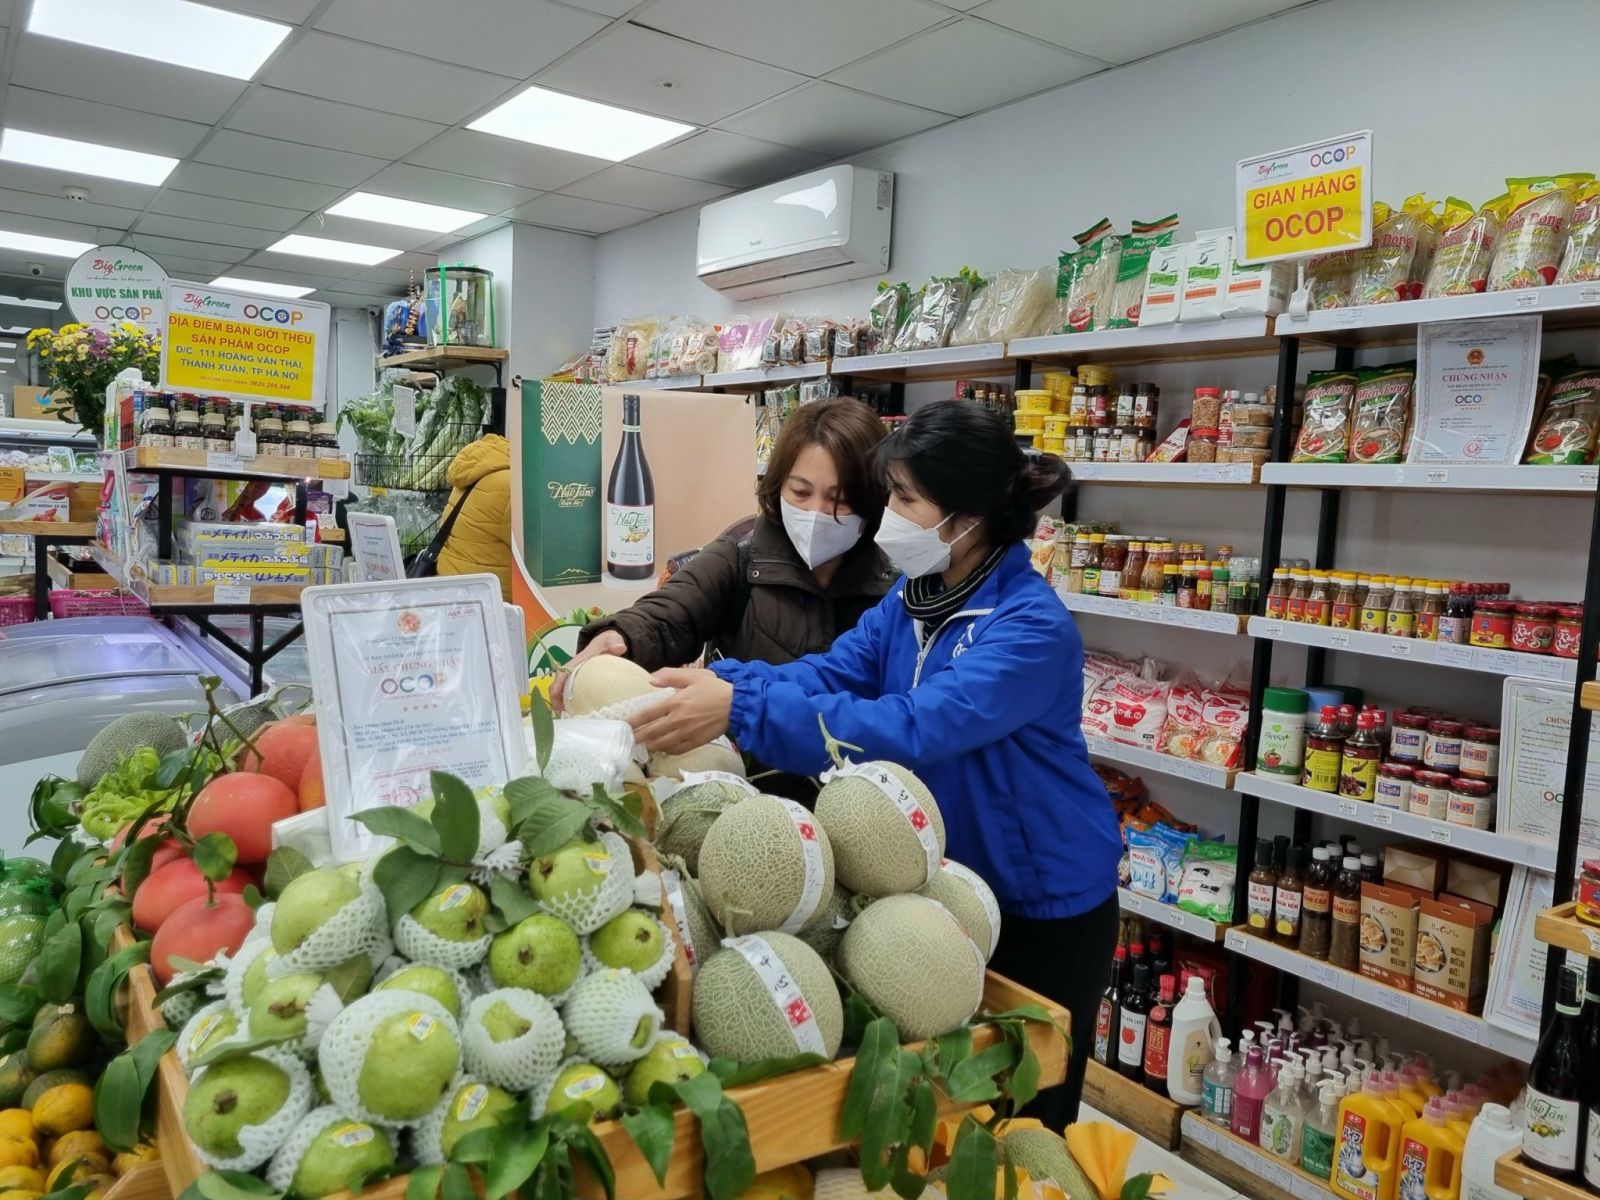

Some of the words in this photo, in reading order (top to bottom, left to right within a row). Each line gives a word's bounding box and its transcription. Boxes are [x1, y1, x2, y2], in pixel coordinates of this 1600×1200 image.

[1311, 145, 1356, 167] OCOP
[1253, 186, 1295, 209] GIAN
[1301, 174, 1356, 200] HÀNG
[1265, 206, 1344, 242] OCOP
[92, 259, 144, 276] BigGreen
[71, 286, 92, 298] KHU
[95, 286, 117, 300] VỰC
[120, 286, 140, 299] SẢN
[183, 292, 232, 309] BigGreen
[95, 305, 153, 321] OCOP
[243, 304, 304, 326] OCOP
[169, 315, 189, 329] ĐỊA
[199, 349, 215, 358] 111
[257, 343, 290, 355] OCOP
[181, 358, 216, 370] THANH
[252, 366, 263, 376] TP
[1442, 371, 1478, 382] CHỨNG
[381, 672, 447, 694] OCOP
